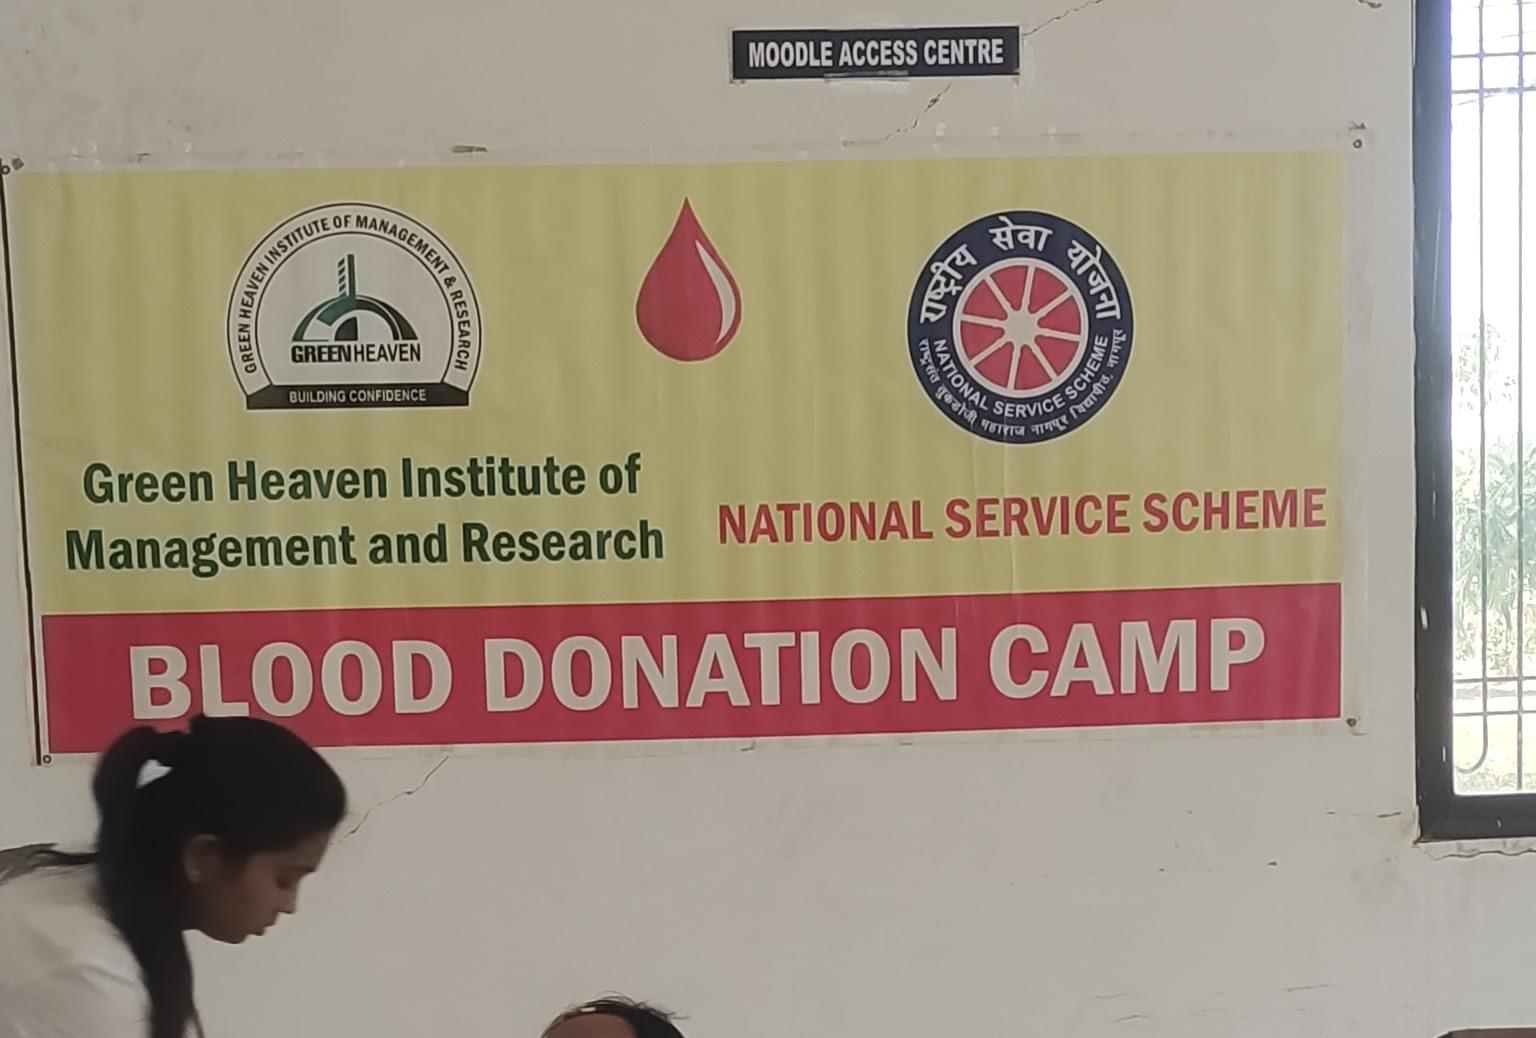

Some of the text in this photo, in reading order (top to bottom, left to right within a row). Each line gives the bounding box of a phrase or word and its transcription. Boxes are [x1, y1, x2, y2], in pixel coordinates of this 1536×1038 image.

[748, 38, 1004, 68] MOODLE ACCESS CENTRE
[238, 215, 471, 374] GREEN HEAVEN INSTITUTE OF MANAGEMENT & RESEARCH
[920, 216, 1121, 324] राष्ट्रीय सेवा योजना
[289, 388, 427, 403] BUILDING CONFIDENCE
[934, 334, 1109, 418] NATIONAL SERVICE SCHEME
[83, 452, 642, 504] Green Heaven Institute of
[718, 487, 1327, 544] NATIONAL SERVICE SCHEME
[65, 519, 665, 578] Management and Research
[129, 617, 1265, 719] BLOOD DONATION CAMP
